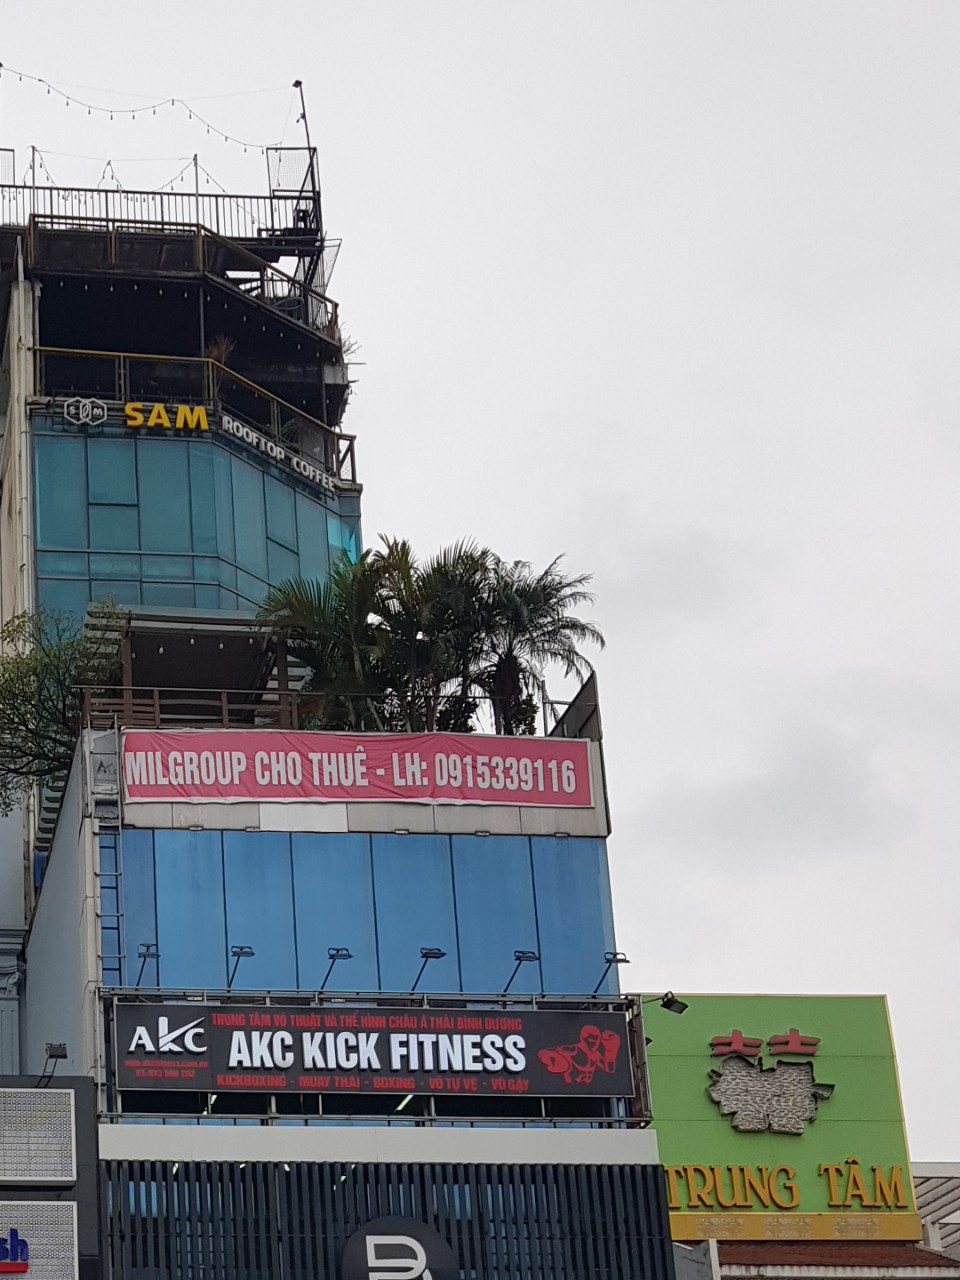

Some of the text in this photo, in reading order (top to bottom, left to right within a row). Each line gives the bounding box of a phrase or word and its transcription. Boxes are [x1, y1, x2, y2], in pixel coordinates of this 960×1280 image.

[124, 402, 209, 431] SAM
[222, 414, 337, 492] ROOFTOP COFFEE
[125, 750, 247, 786] MILGROUP
[254, 751, 303, 787] CHO
[308, 745, 369, 787] THUÊ
[391, 752, 429, 788] LH:
[434, 752, 577, 794] 0915339116
[211, 1012, 246, 1027] TRUNG
[249, 1010, 271, 1027] TÂM
[228, 1030, 527, 1073] AKC KICK FITNESS
[216, 1074, 287, 1087] KICKBOXING
[299, 1075, 331, 1088] MUAY
[373, 1076, 415, 1090] BOXING
[664, 1155, 909, 1209] TRUNG TÂM
